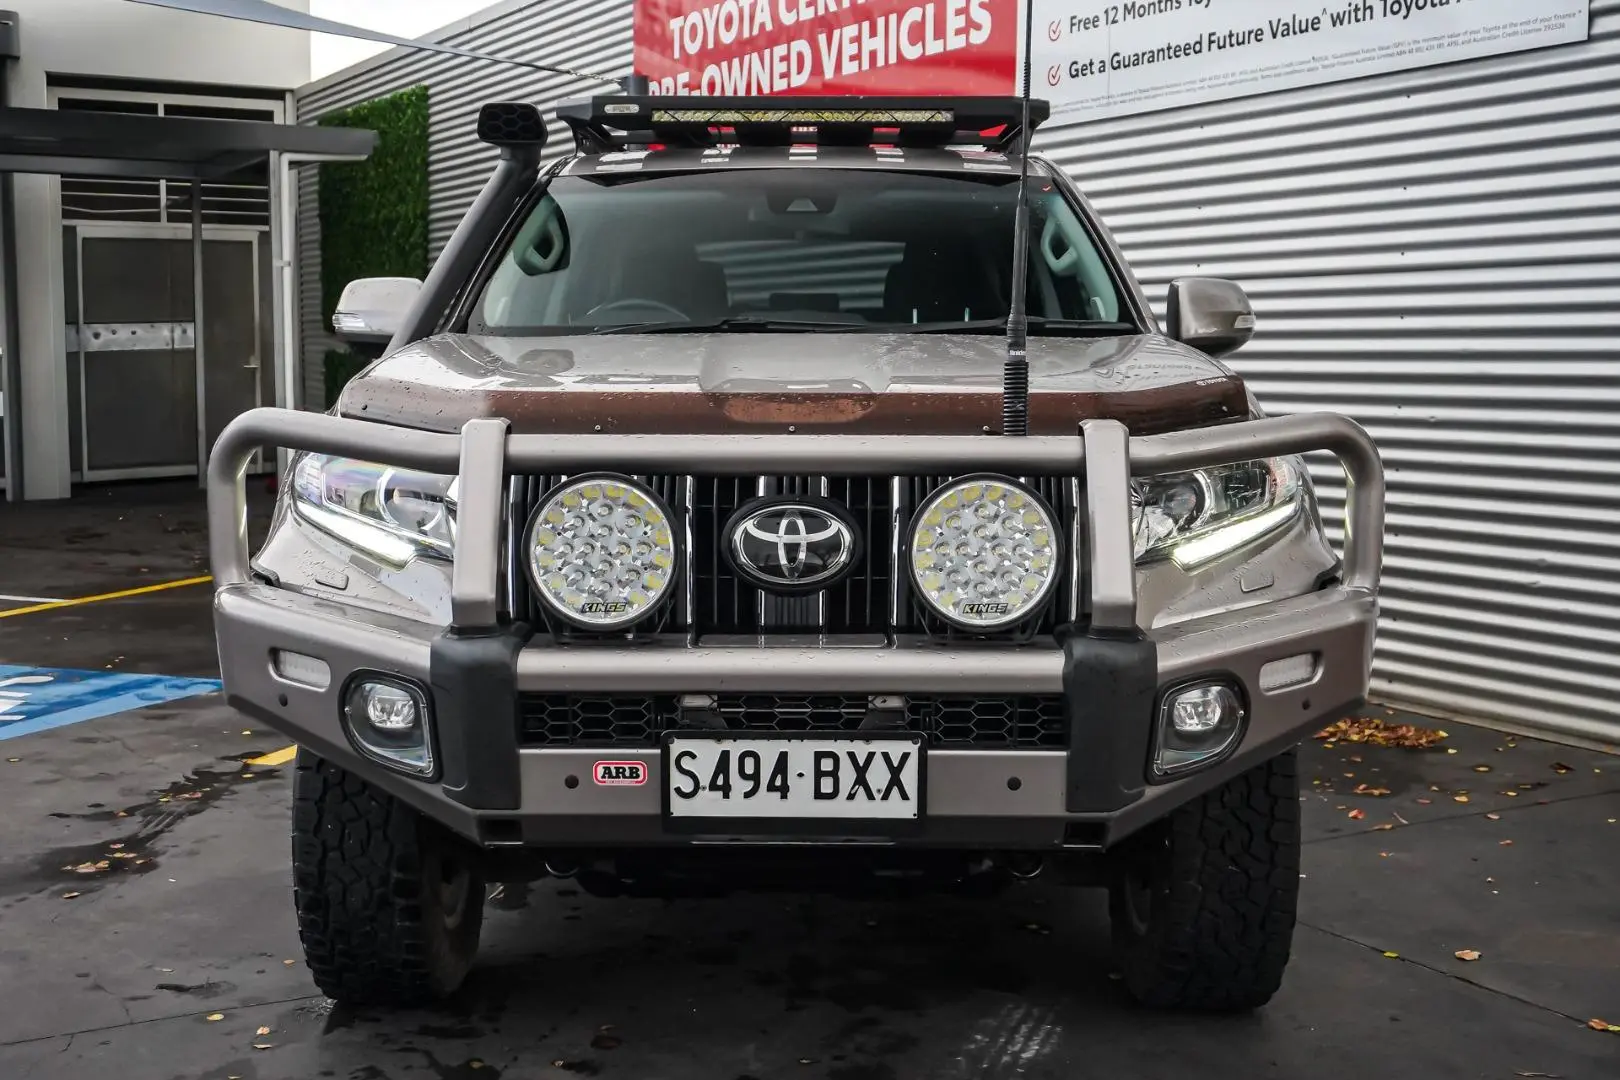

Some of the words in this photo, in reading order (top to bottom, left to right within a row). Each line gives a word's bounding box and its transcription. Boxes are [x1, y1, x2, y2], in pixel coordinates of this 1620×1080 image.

[670, 0, 773, 59] TOYOTA
[1070, 15, 1100, 33] Free
[1104, 7, 1119, 26] 12
[1123, 0, 1181, 21] Months
[817, 0, 992, 80] VEHICLES
[1068, 57, 1094, 79] Get
[1098, 60, 1106, 73] a
[1110, 33, 1202, 71] Guaranteed
[1207, 27, 1264, 52] Future
[1330, 0, 1374, 28] with
[582, 602, 626, 613] KINGS
[964, 603, 1008, 614] KINGS
[600, 766, 640, 779] ARB
